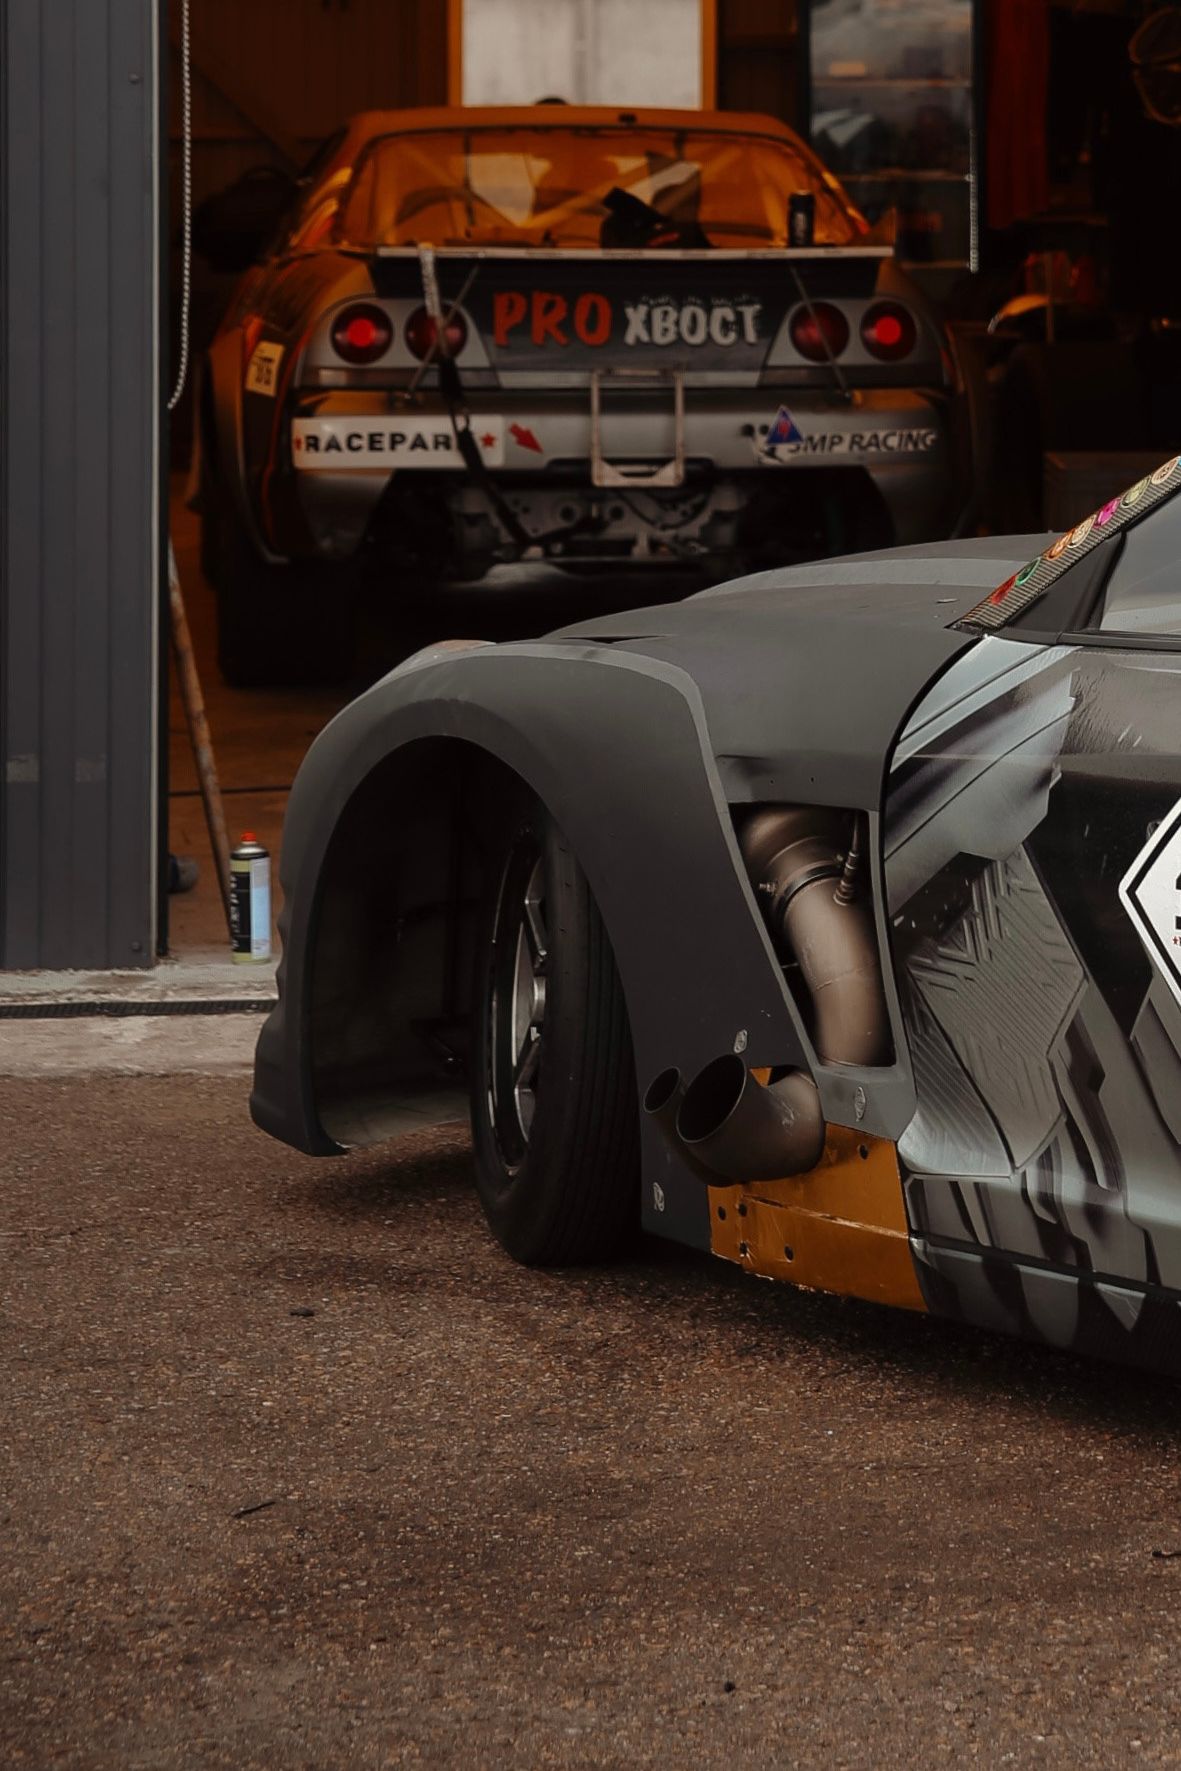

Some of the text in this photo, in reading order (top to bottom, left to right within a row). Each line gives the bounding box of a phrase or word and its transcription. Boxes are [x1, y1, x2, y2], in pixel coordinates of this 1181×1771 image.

[493, 291, 613, 347] PRO
[304, 431, 462, 453] RACEPAR
[849, 430, 937, 452] RACING
